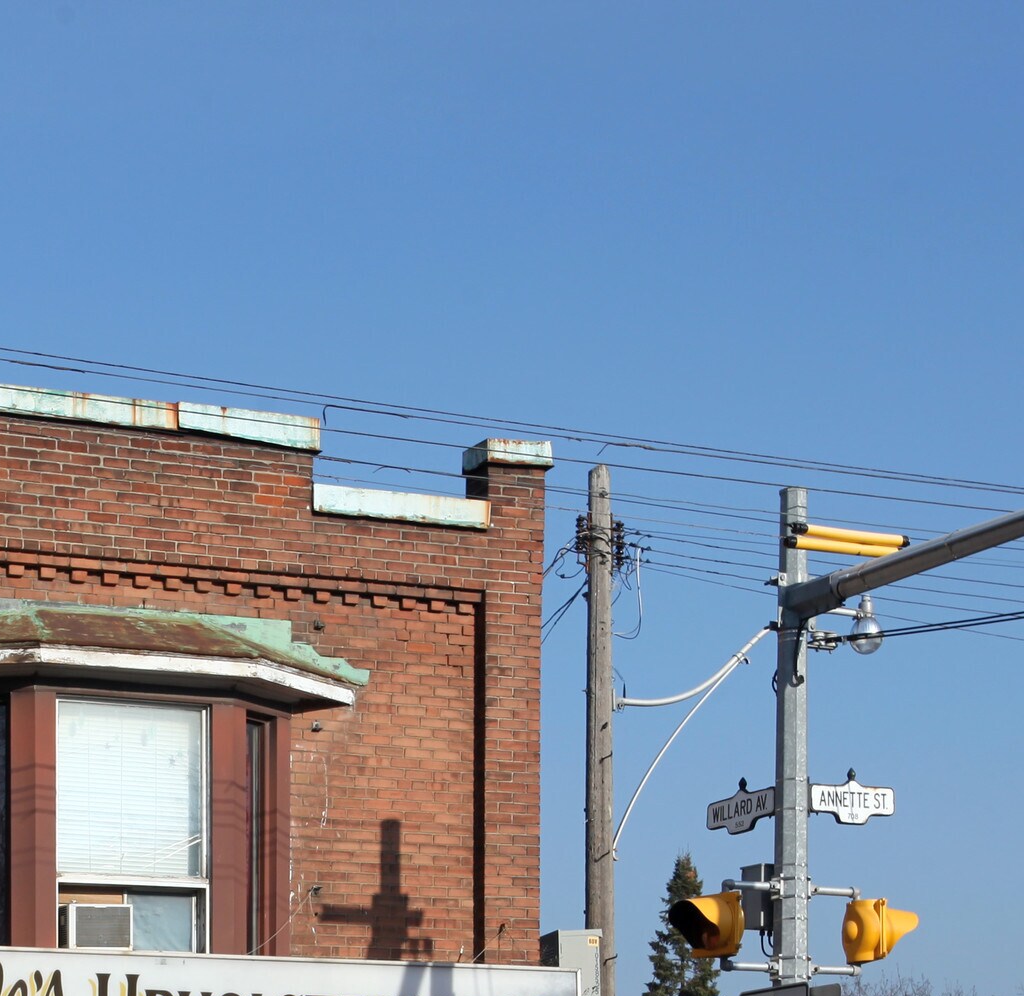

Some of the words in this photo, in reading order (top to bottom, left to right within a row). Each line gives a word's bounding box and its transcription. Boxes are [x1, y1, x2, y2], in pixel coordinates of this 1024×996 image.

[712, 797, 753, 824] WILLARD
[755, 793, 768, 812] AV.
[819, 790, 870, 809] ANNETTE
[873, 792, 889, 810] ST.
[847, 812, 859, 820] 708
